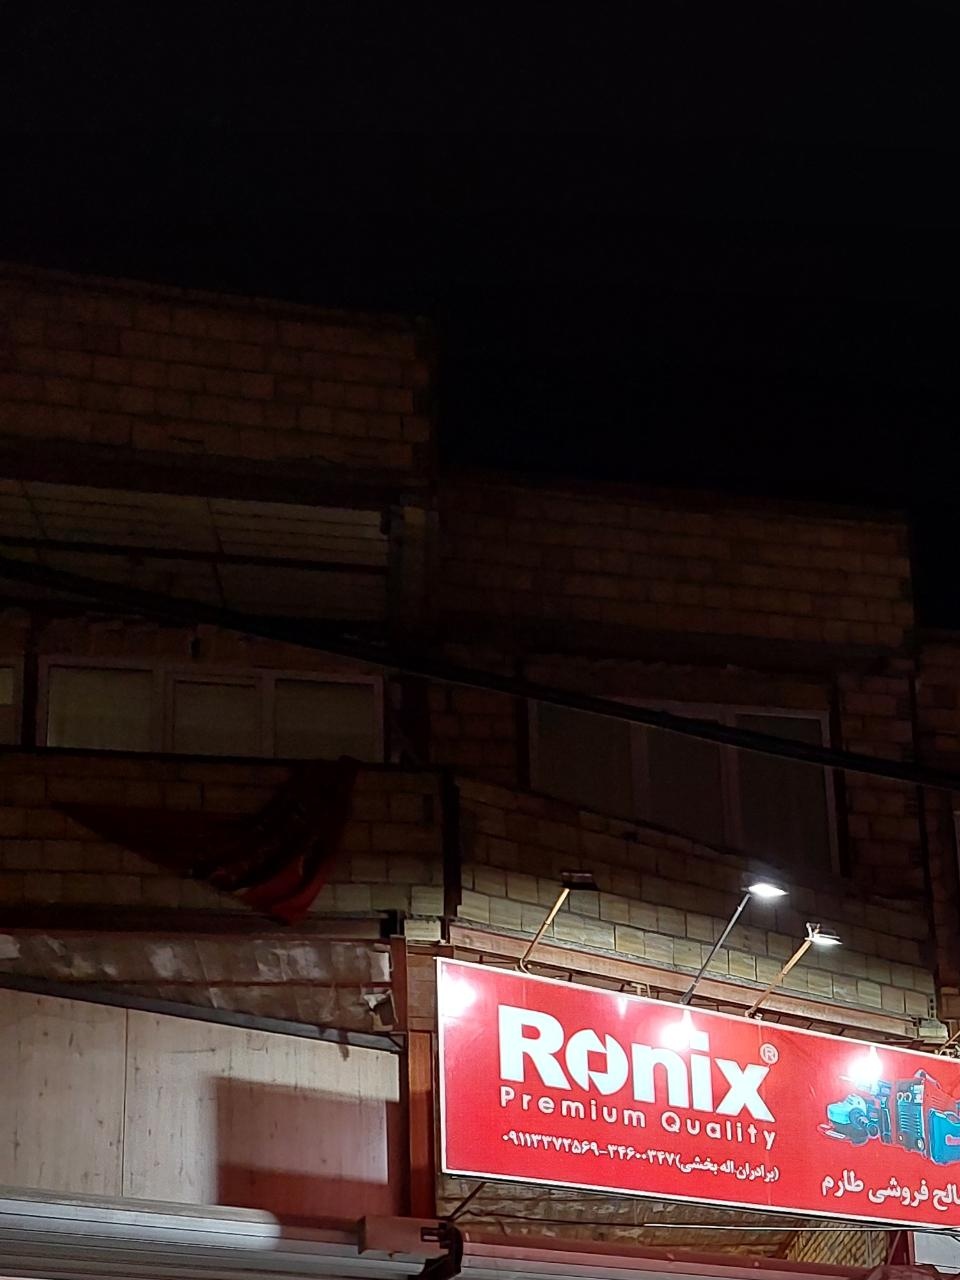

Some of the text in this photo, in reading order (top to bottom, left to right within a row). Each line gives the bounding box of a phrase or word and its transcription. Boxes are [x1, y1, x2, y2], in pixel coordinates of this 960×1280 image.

[498, 1005, 776, 1123] Ronix
[500, 1085, 776, 1150] Premium Quality
[821, 1169, 864, 1196] طارم
[868, 1177, 929, 1208] فروشی
